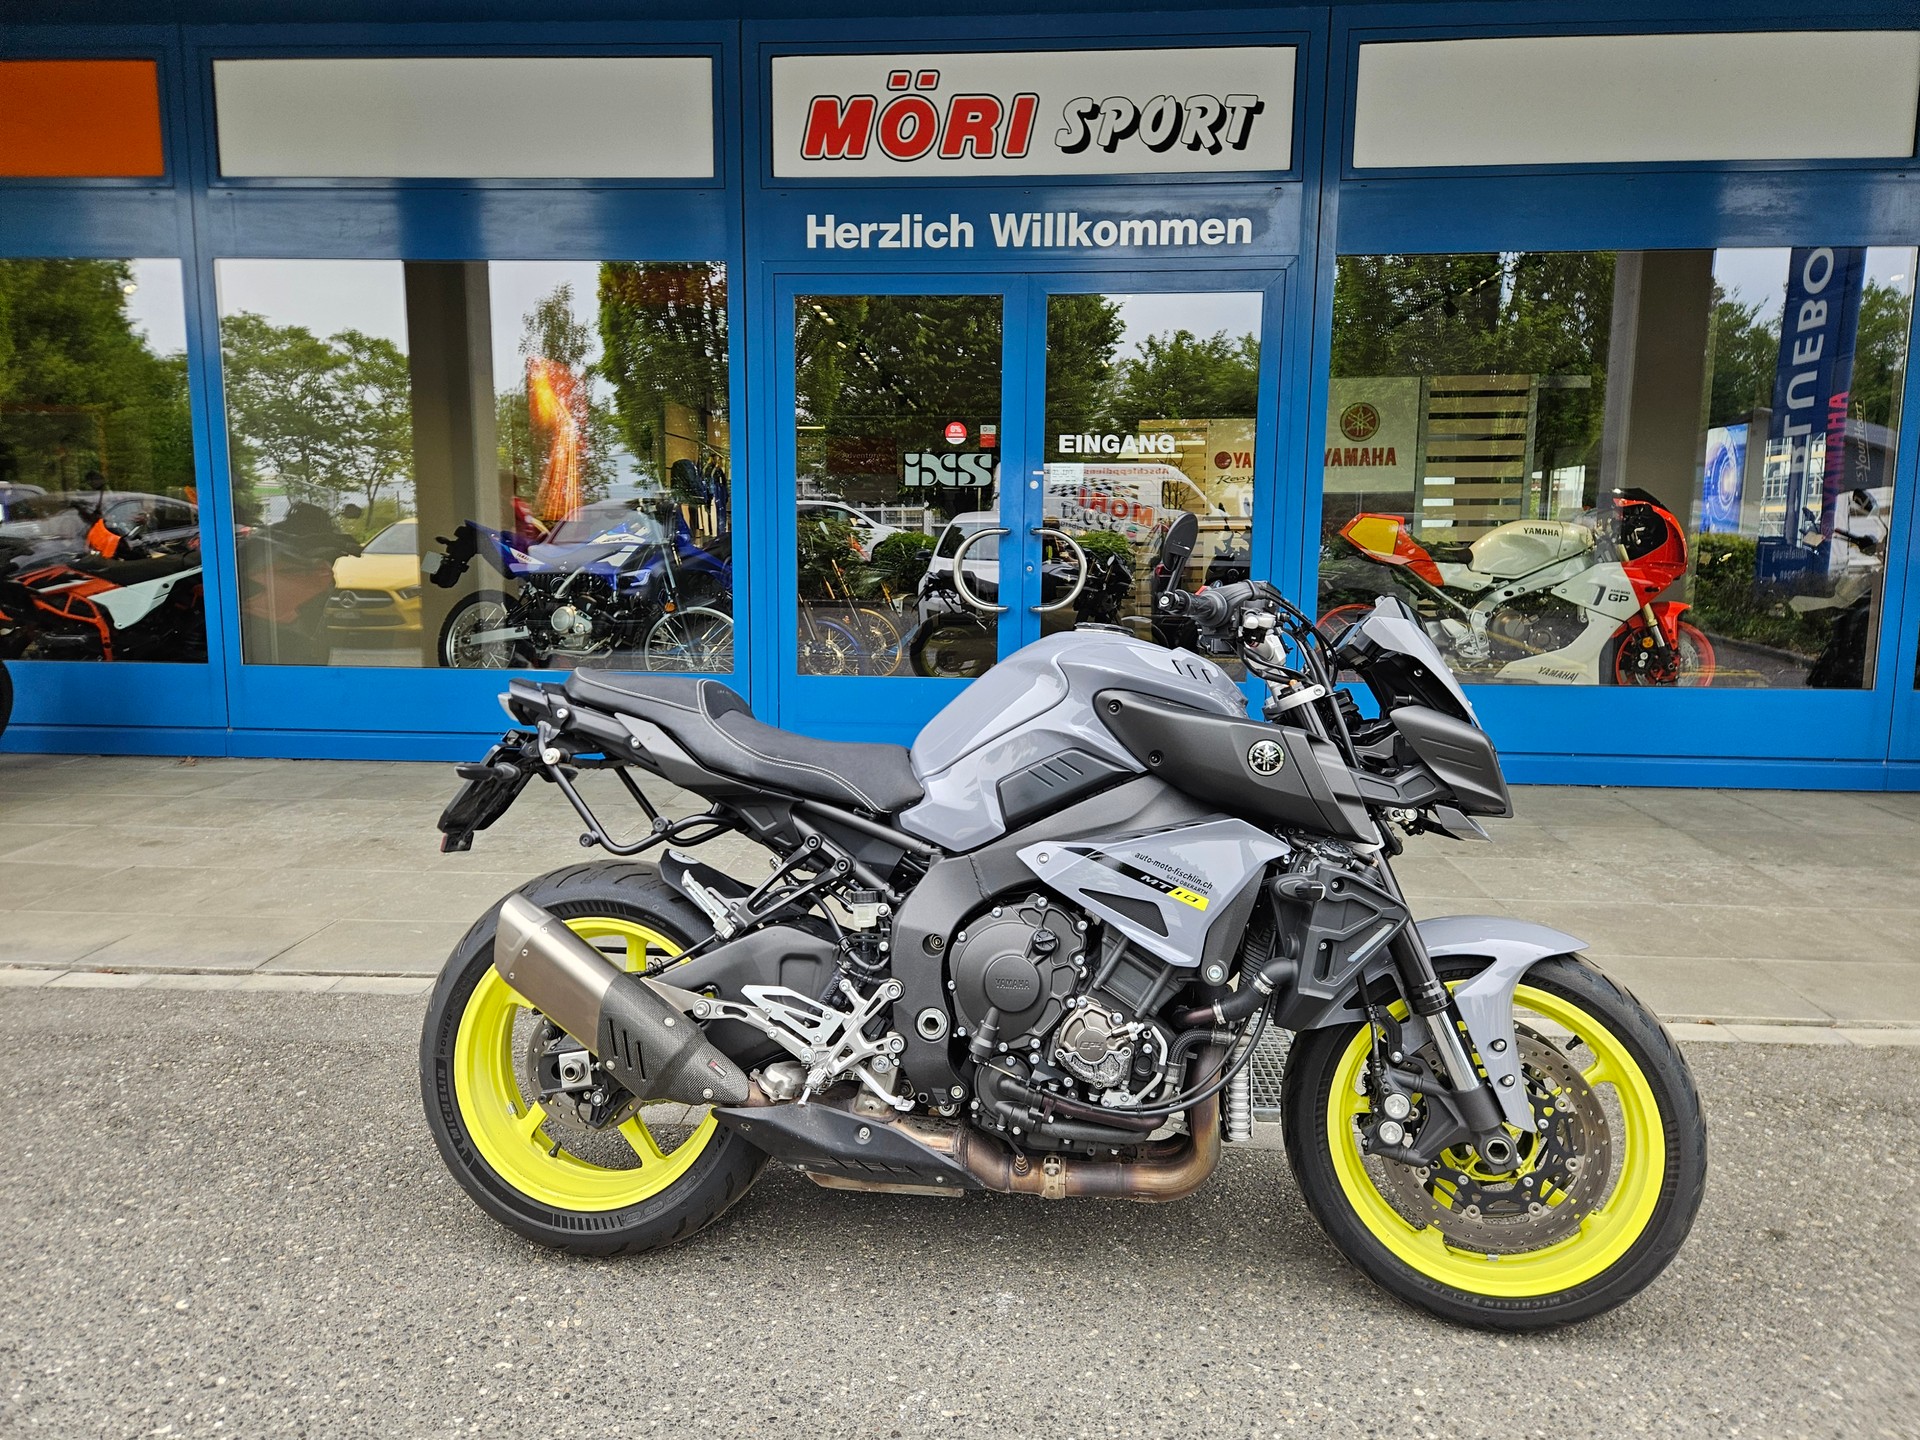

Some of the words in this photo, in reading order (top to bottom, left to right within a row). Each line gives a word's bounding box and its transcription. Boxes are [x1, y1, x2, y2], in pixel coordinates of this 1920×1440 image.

[800, 69, 1040, 162] MÖRI
[1055, 93, 1264, 155] SPORT
[806, 213, 974, 250] Herzlich
[990, 212, 1253, 247] Willkommen
[1059, 434, 1175, 454] EINGANG
[1324, 446, 1397, 467] YAMAHA
[1523, 527, 1560, 537] YAMAHA
[1608, 593, 1629, 602] GP
[1538, 666, 1575, 681] YAMAHA
[1134, 853, 1213, 889] auto-moto-fischlin.ch
[1140, 875, 1173, 891] MT
[1175, 890, 1198, 902] 10
[995, 978, 1030, 990] YAMAHA
[439, 1014, 453, 1055] POWER
[437, 1068, 462, 1140] MICHELIN
[1484, 1296, 1561, 1310] MICHELIN
